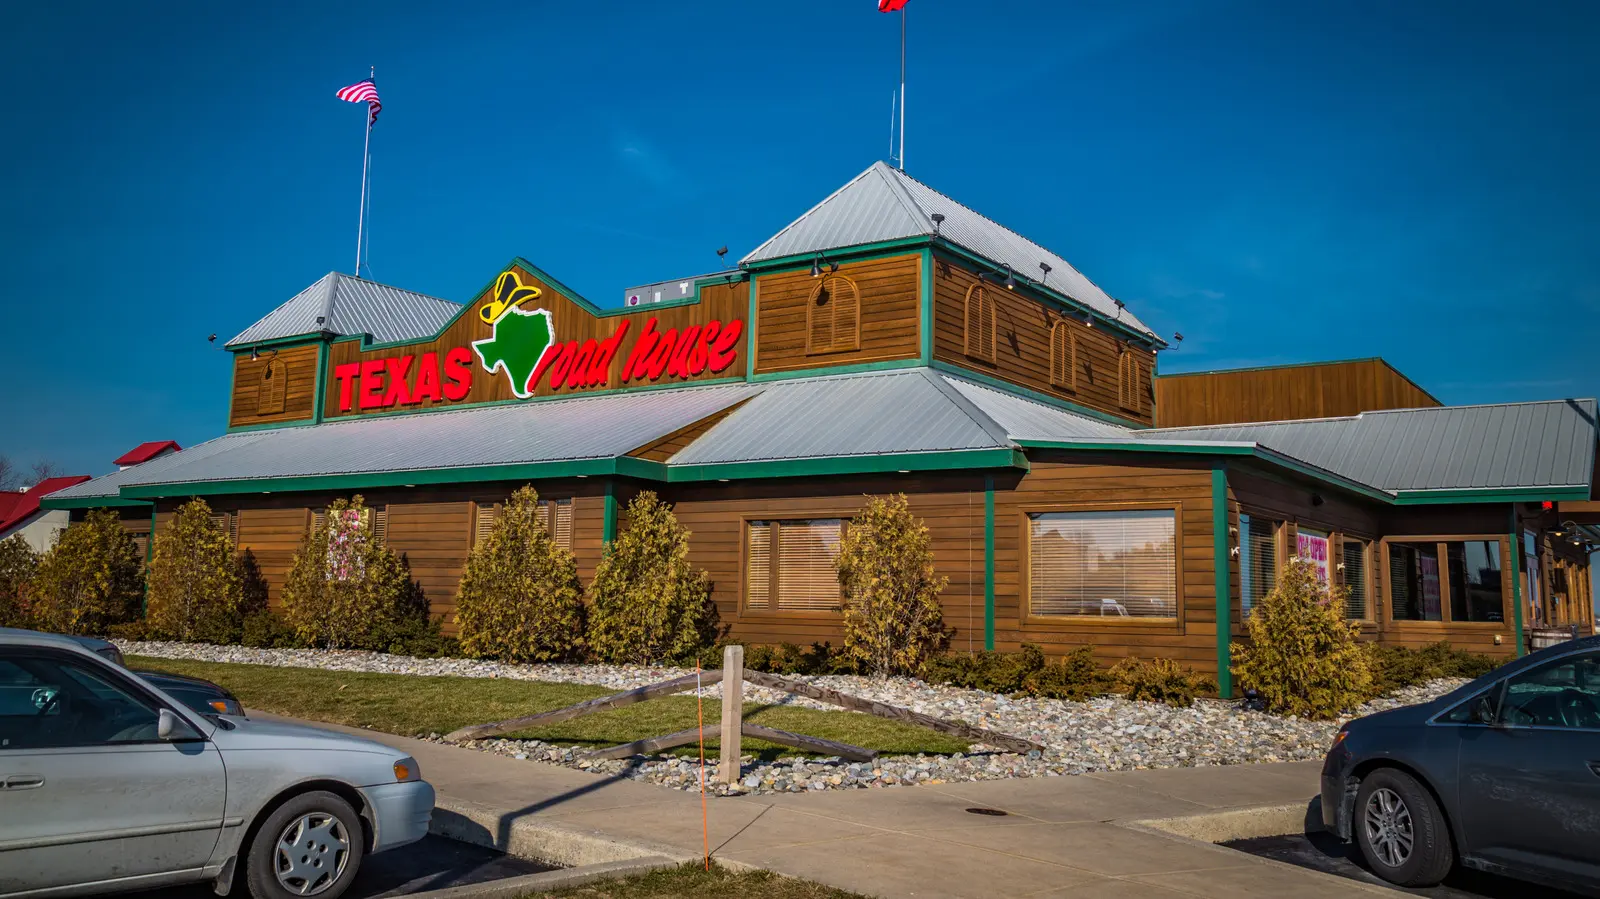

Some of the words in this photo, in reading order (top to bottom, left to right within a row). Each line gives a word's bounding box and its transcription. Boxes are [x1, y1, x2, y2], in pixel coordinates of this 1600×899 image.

[335, 346, 473, 412] TEXAS
[526, 319, 631, 393] road
[621, 317, 743, 384] house
